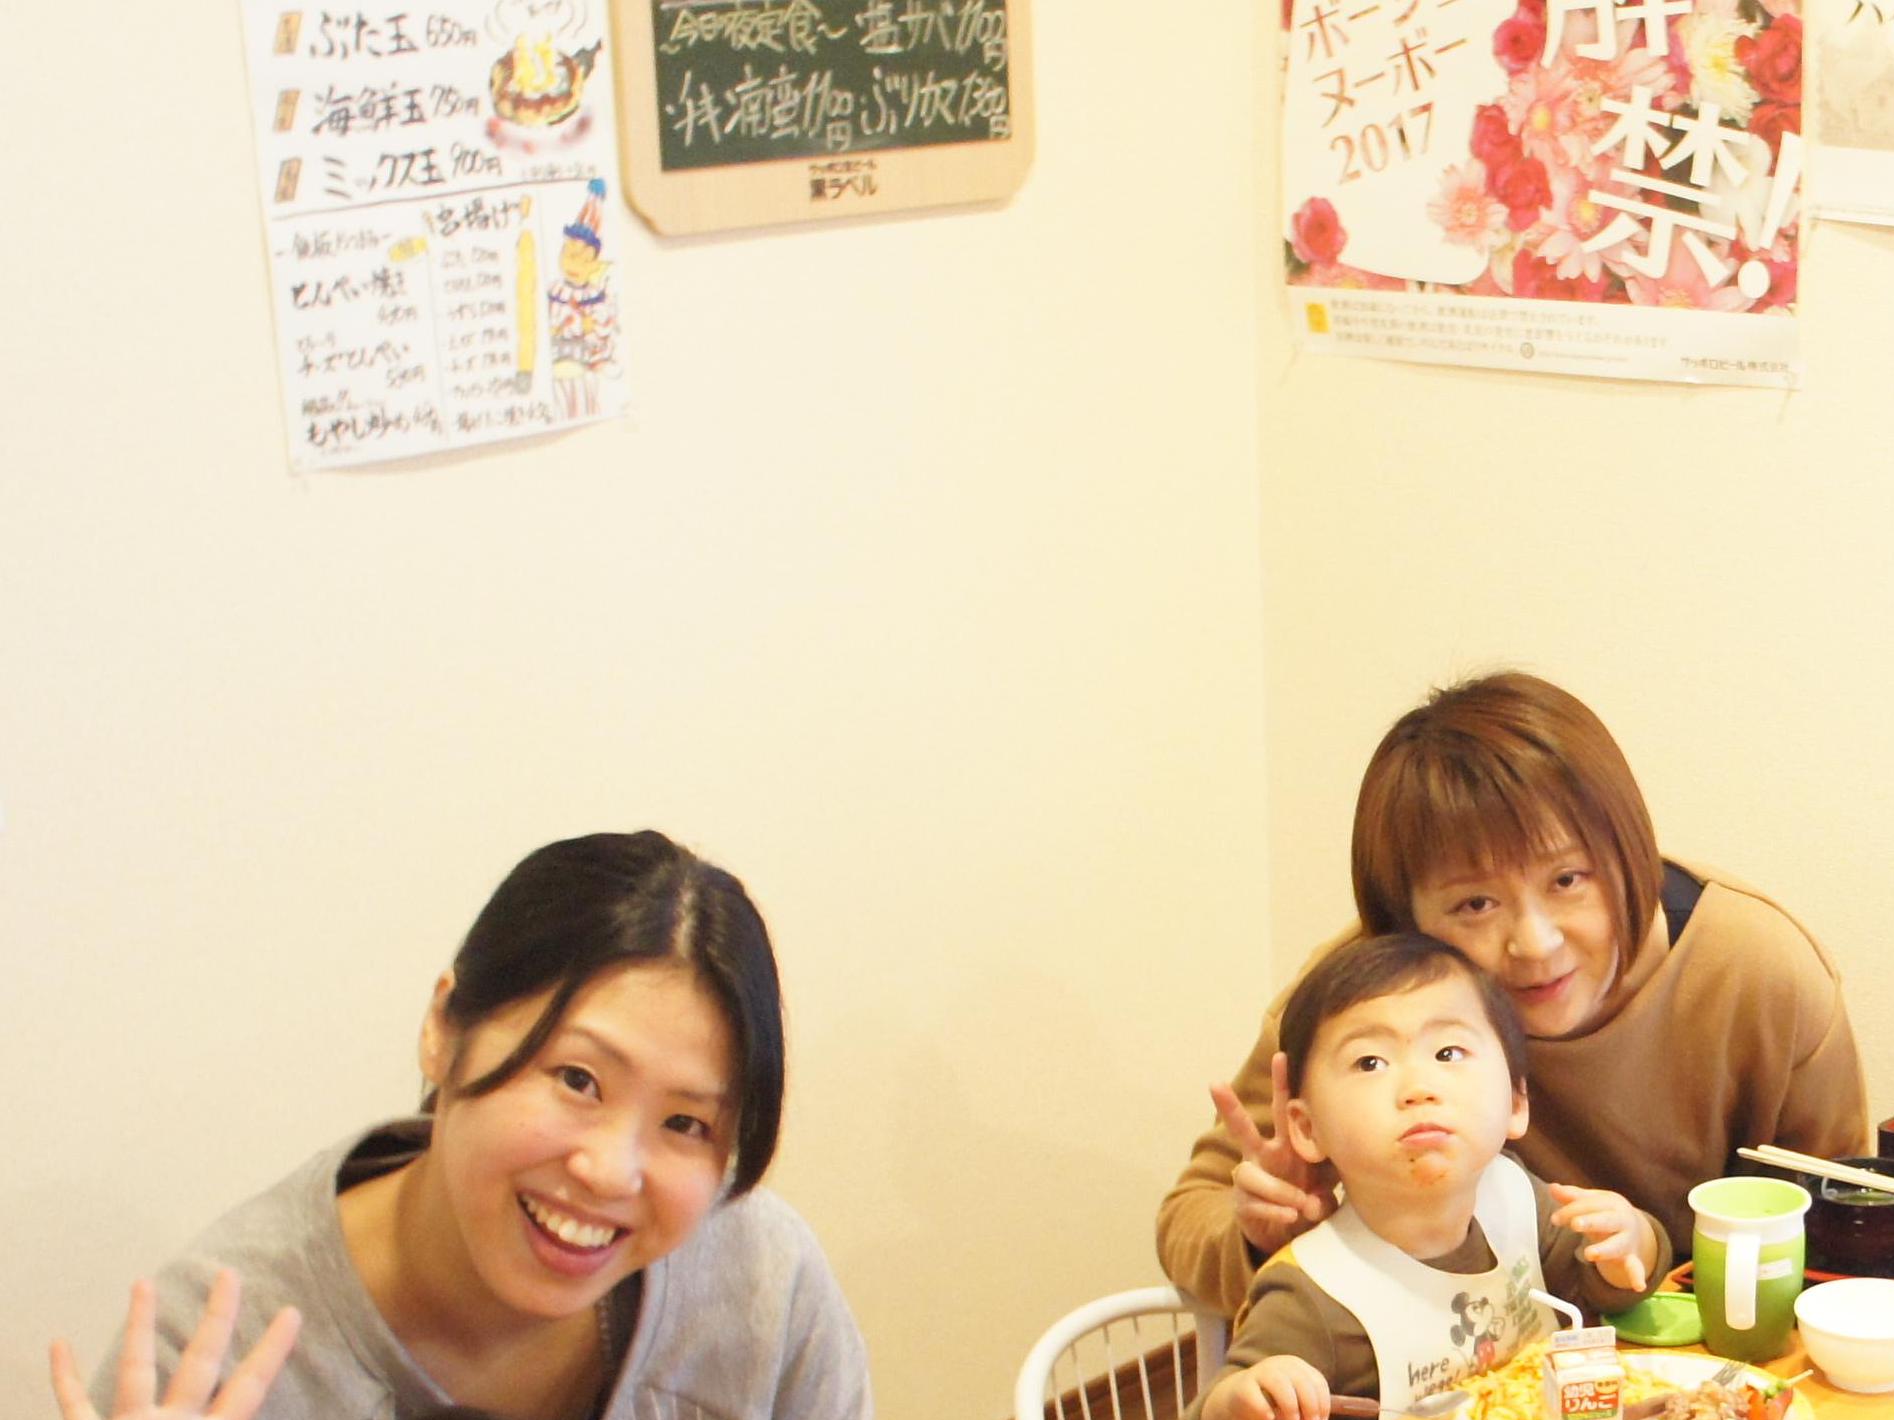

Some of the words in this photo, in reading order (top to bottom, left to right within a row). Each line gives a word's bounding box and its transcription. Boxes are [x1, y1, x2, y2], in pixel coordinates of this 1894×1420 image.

[1312, 27, 1467, 128] ヌーボー
[1329, 101, 1434, 185] 2017
[810, 175, 878, 200] 黒ラベル
[1408, 1358, 1449, 1387] here
